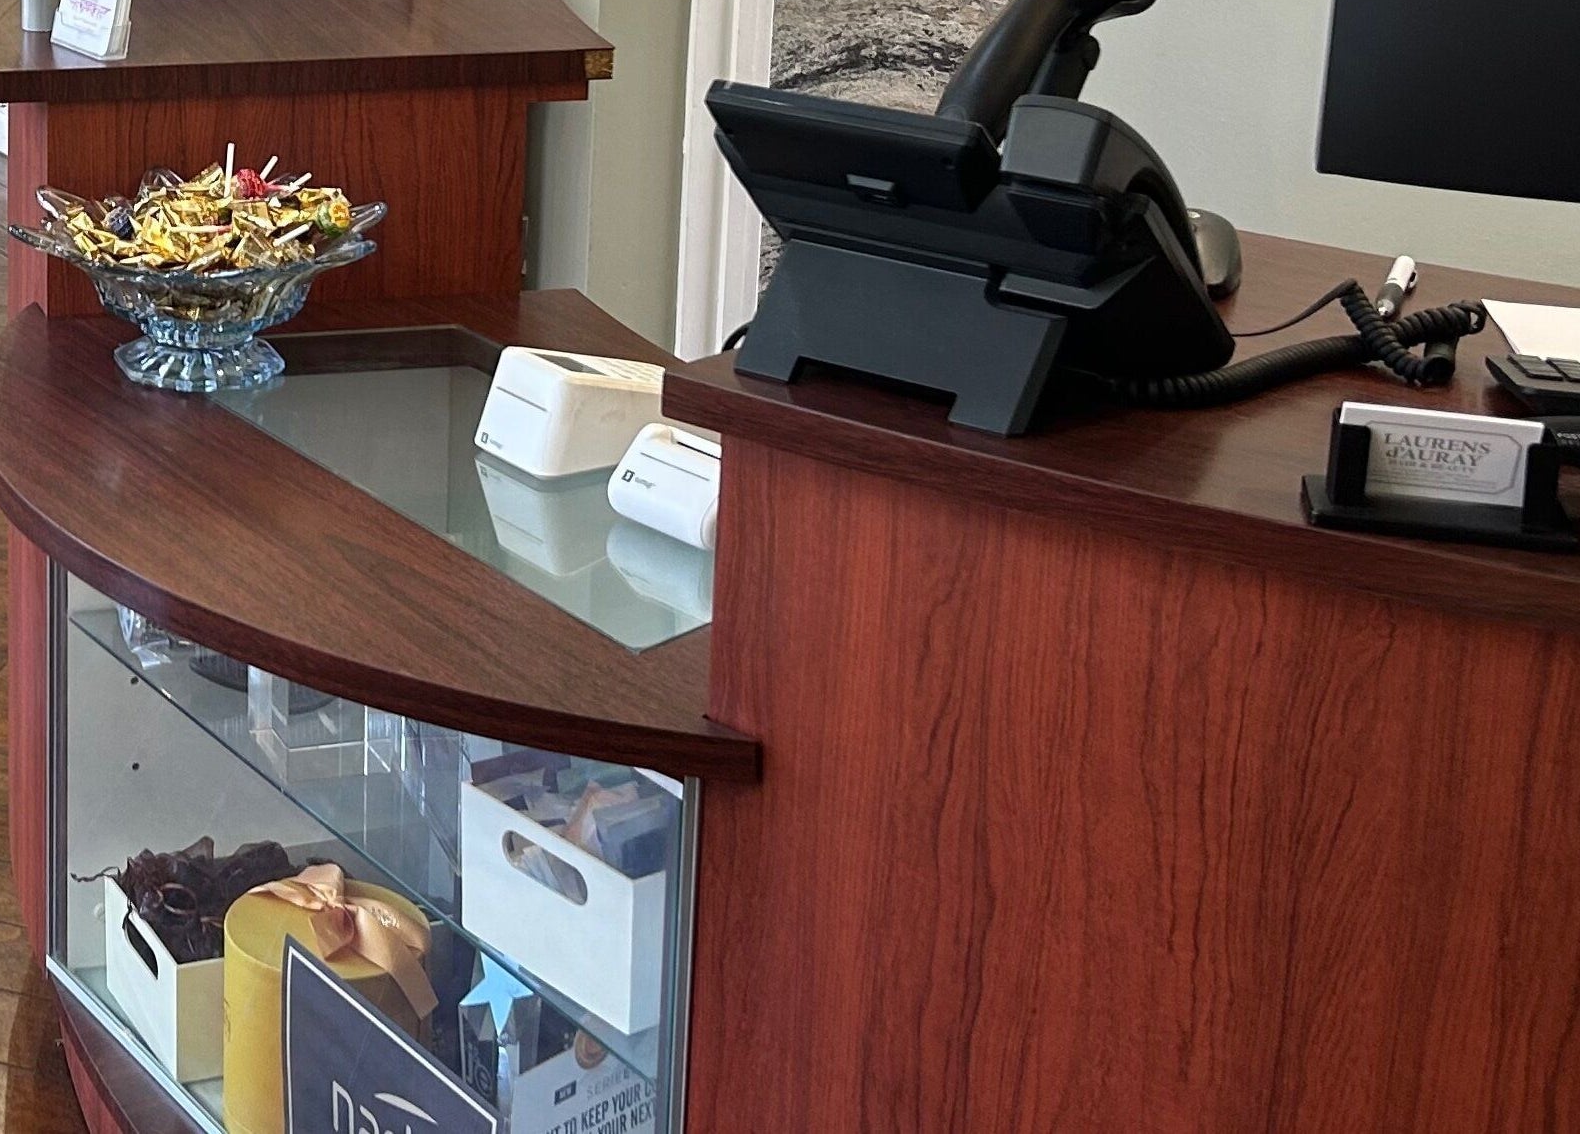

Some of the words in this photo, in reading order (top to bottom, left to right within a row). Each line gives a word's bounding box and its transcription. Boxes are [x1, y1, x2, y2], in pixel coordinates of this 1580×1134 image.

[1384, 433, 1491, 454] LAURENS
[581, 1100, 609, 1131] KEEP
[612, 1083, 641, 1114] YOUR
